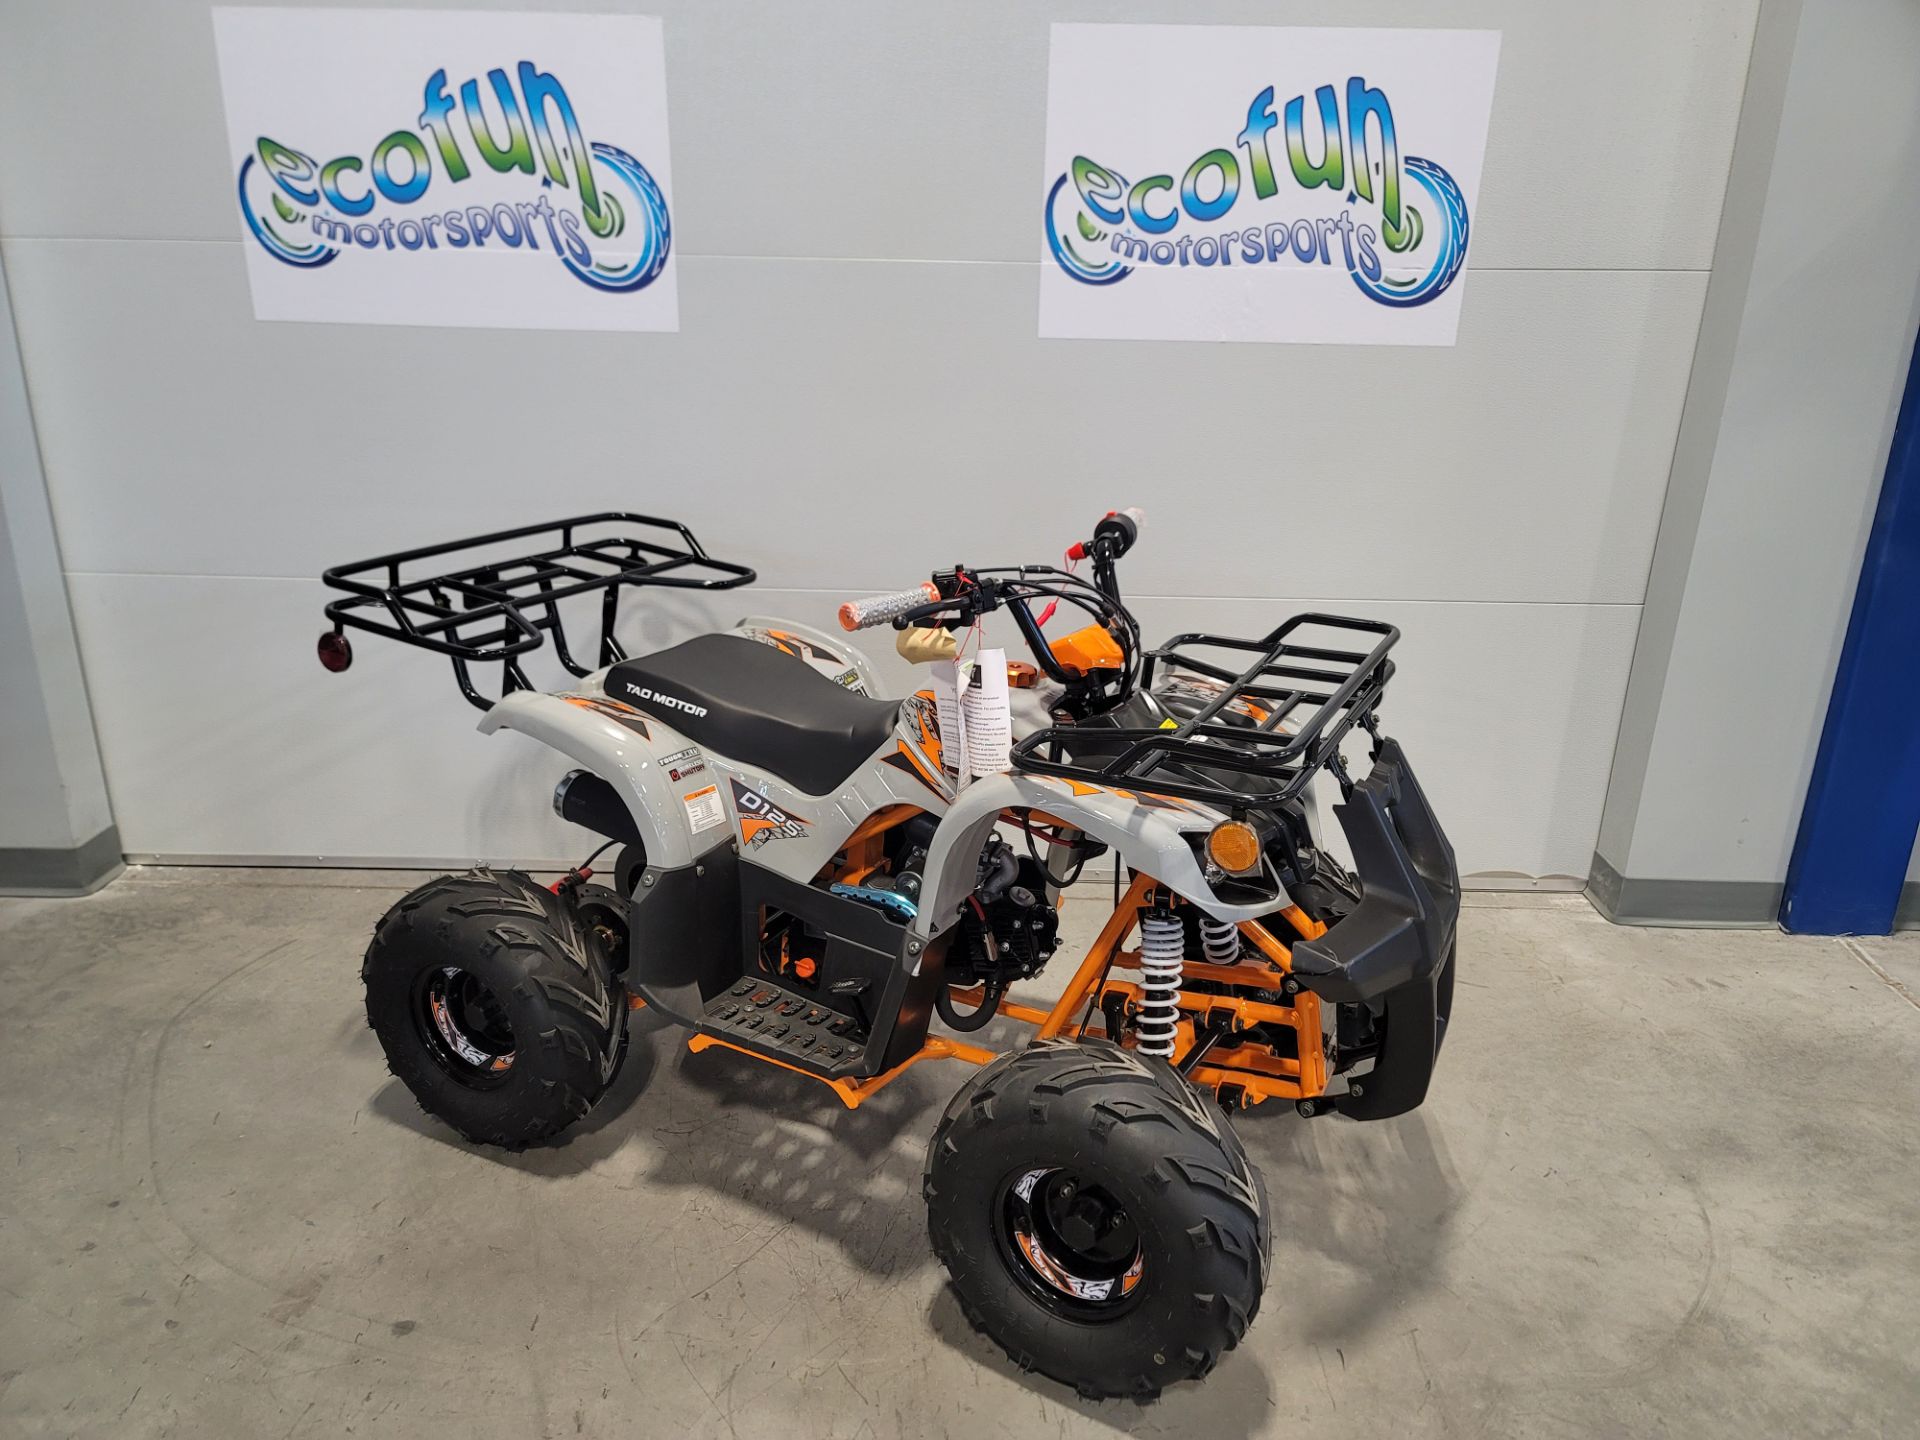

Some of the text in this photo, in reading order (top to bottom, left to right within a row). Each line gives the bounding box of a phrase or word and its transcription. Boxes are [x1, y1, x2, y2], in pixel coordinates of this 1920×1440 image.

[312, 195, 592, 268] motorsports
[1110, 210, 1382, 282] motorsports
[626, 682, 708, 718] TAO MOTOR
[738, 791, 802, 837] D125
